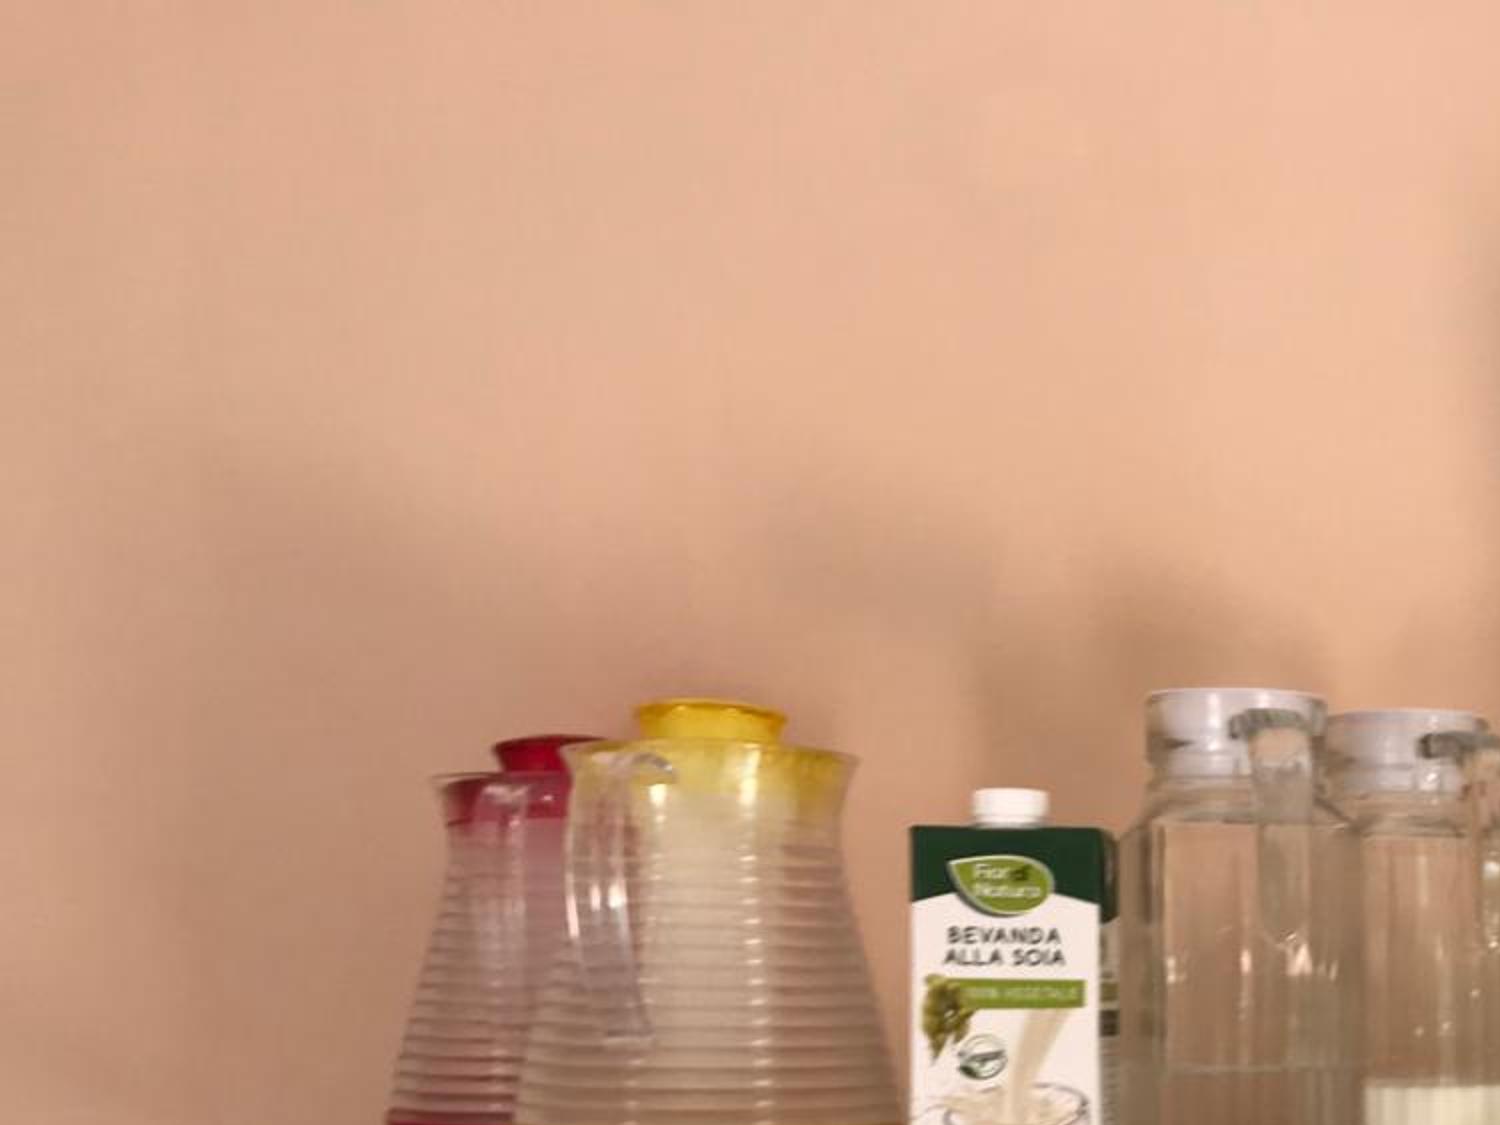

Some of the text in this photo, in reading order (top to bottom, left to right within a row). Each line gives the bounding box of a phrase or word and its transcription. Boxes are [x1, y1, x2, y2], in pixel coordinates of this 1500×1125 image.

[947, 926, 1061, 945] BEVANDA
[943, 949, 1067, 966] ALLA SOIA
